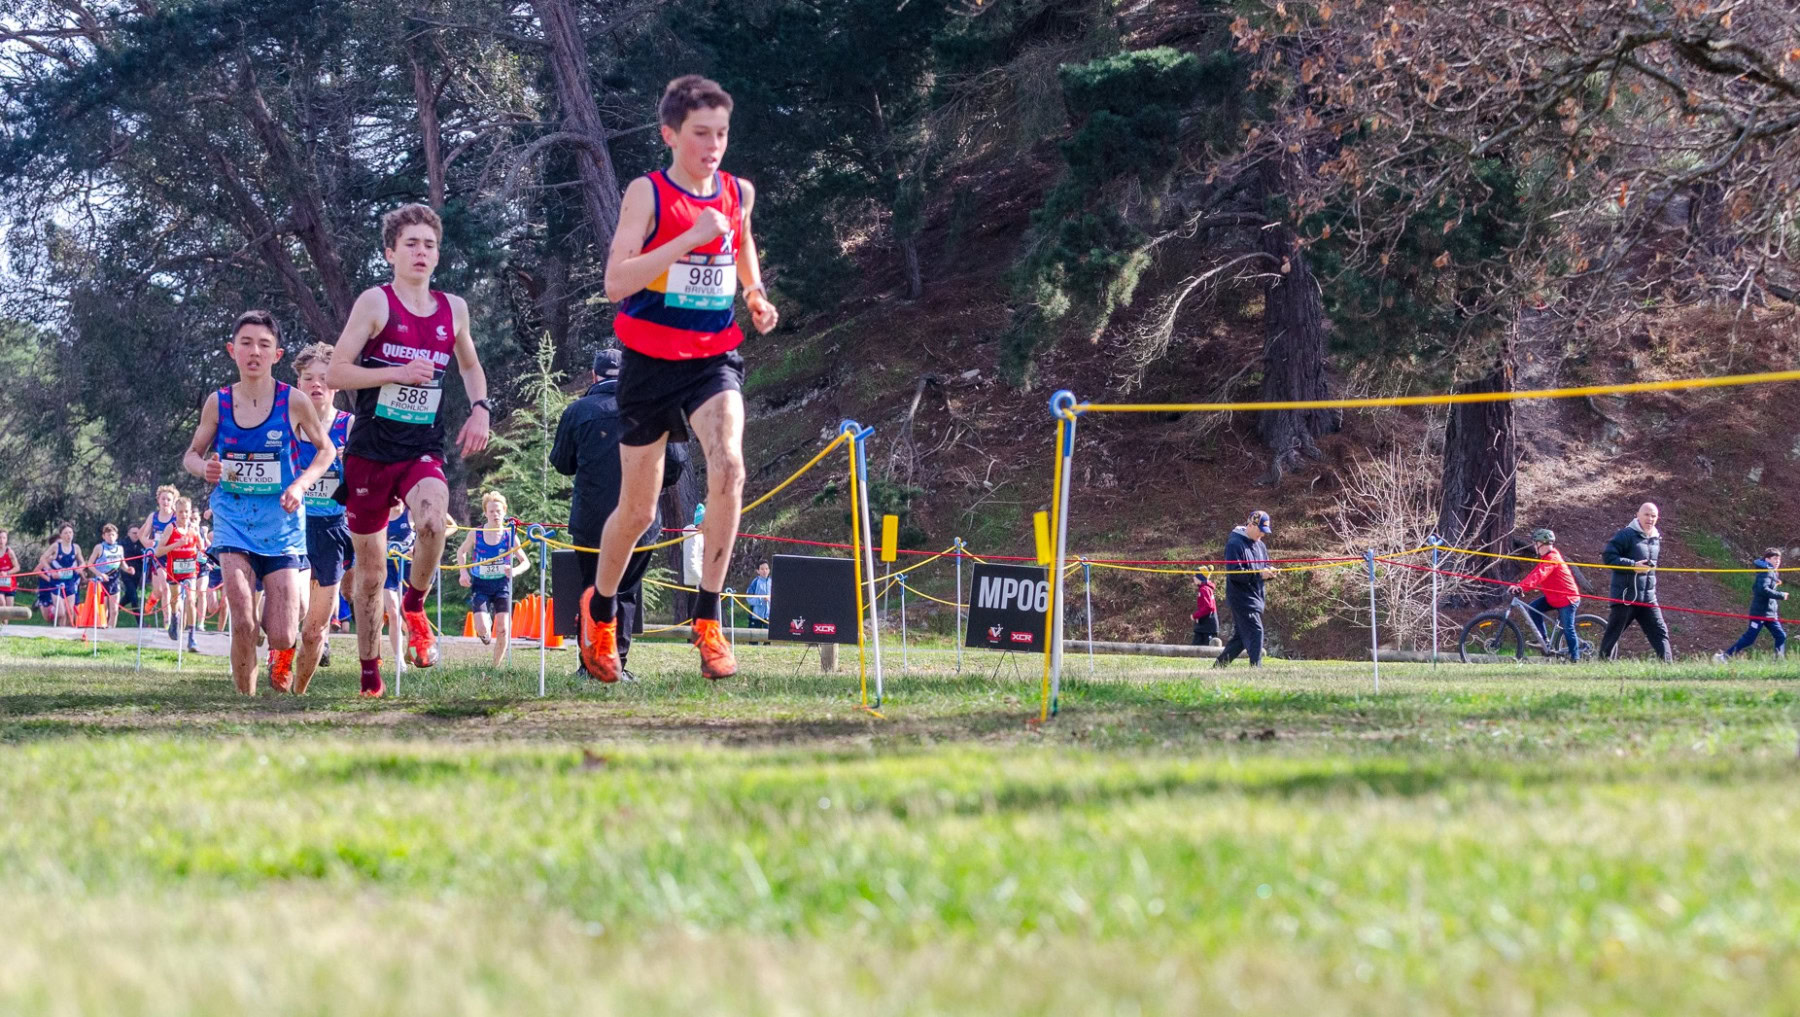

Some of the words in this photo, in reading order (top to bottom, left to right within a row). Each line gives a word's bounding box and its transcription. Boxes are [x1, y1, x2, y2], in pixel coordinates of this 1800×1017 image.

[689, 267, 723, 287] 980
[382, 342, 451, 367] QUEENSLAND
[397, 387, 429, 405] 588
[391, 400, 429, 412] FROHLICH
[235, 462, 265, 477] 275
[978, 575, 1050, 613] MP06
[814, 625, 835, 633] XCR
[1011, 633, 1032, 642] XCR
